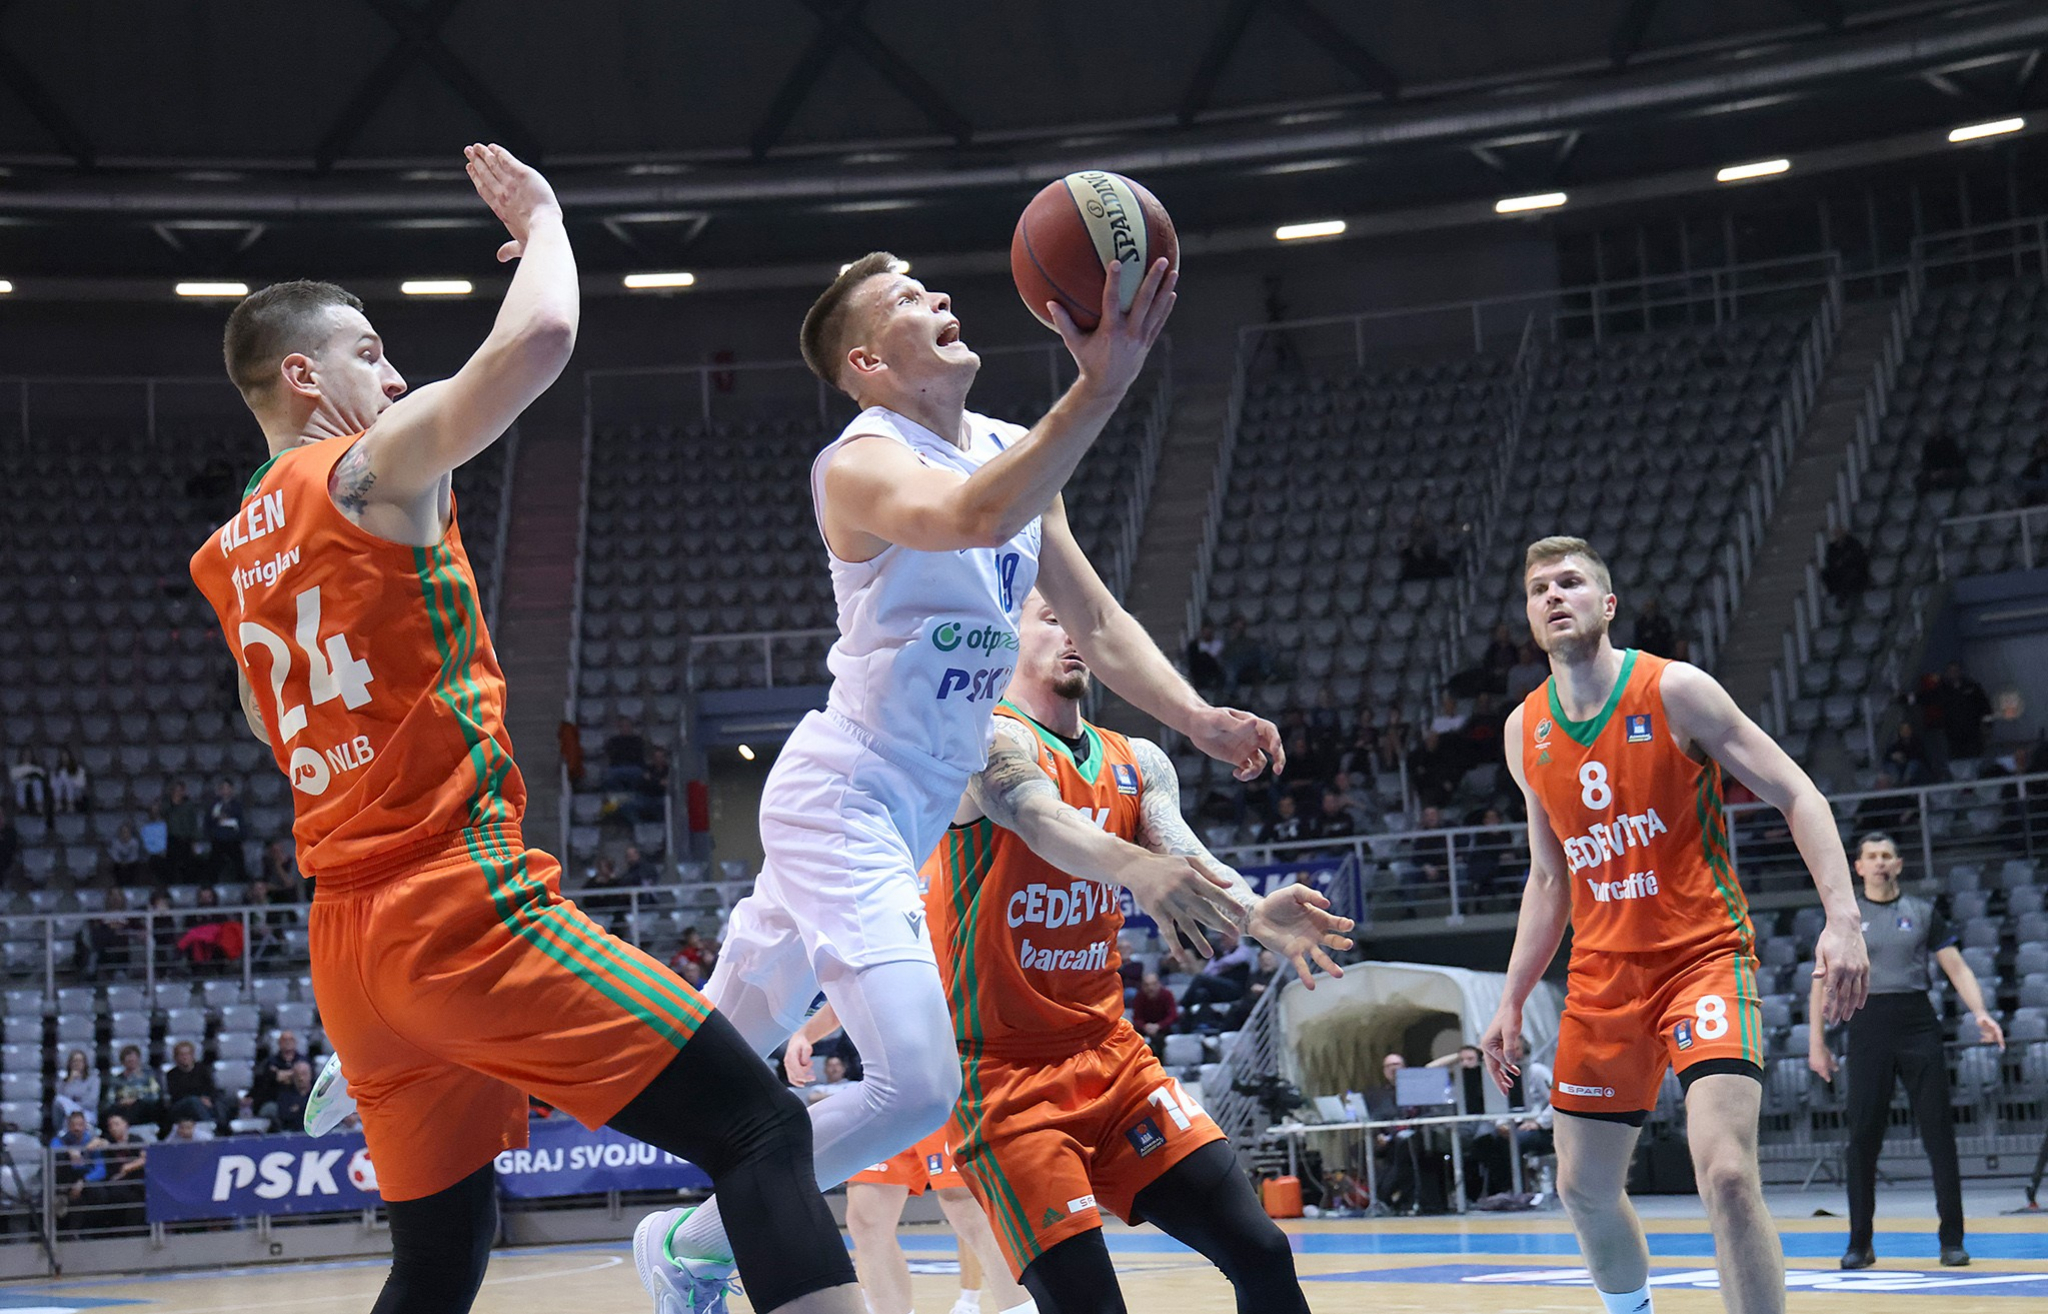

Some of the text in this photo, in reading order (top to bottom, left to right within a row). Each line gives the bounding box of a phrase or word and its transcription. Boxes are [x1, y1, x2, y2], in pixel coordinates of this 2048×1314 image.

[220, 489, 286, 559] ALEN
[242, 546, 300, 587] triglav
[238, 585, 374, 744] 24
[326, 735, 375, 775] NLB
[1579, 761, 1612, 810] 8
[1695, 995, 1728, 1039] 8
[1568, 1086, 1601, 1095] SPAR
[212, 1149, 344, 1200] PSK
[570, 1143, 657, 1169] SVOJU
